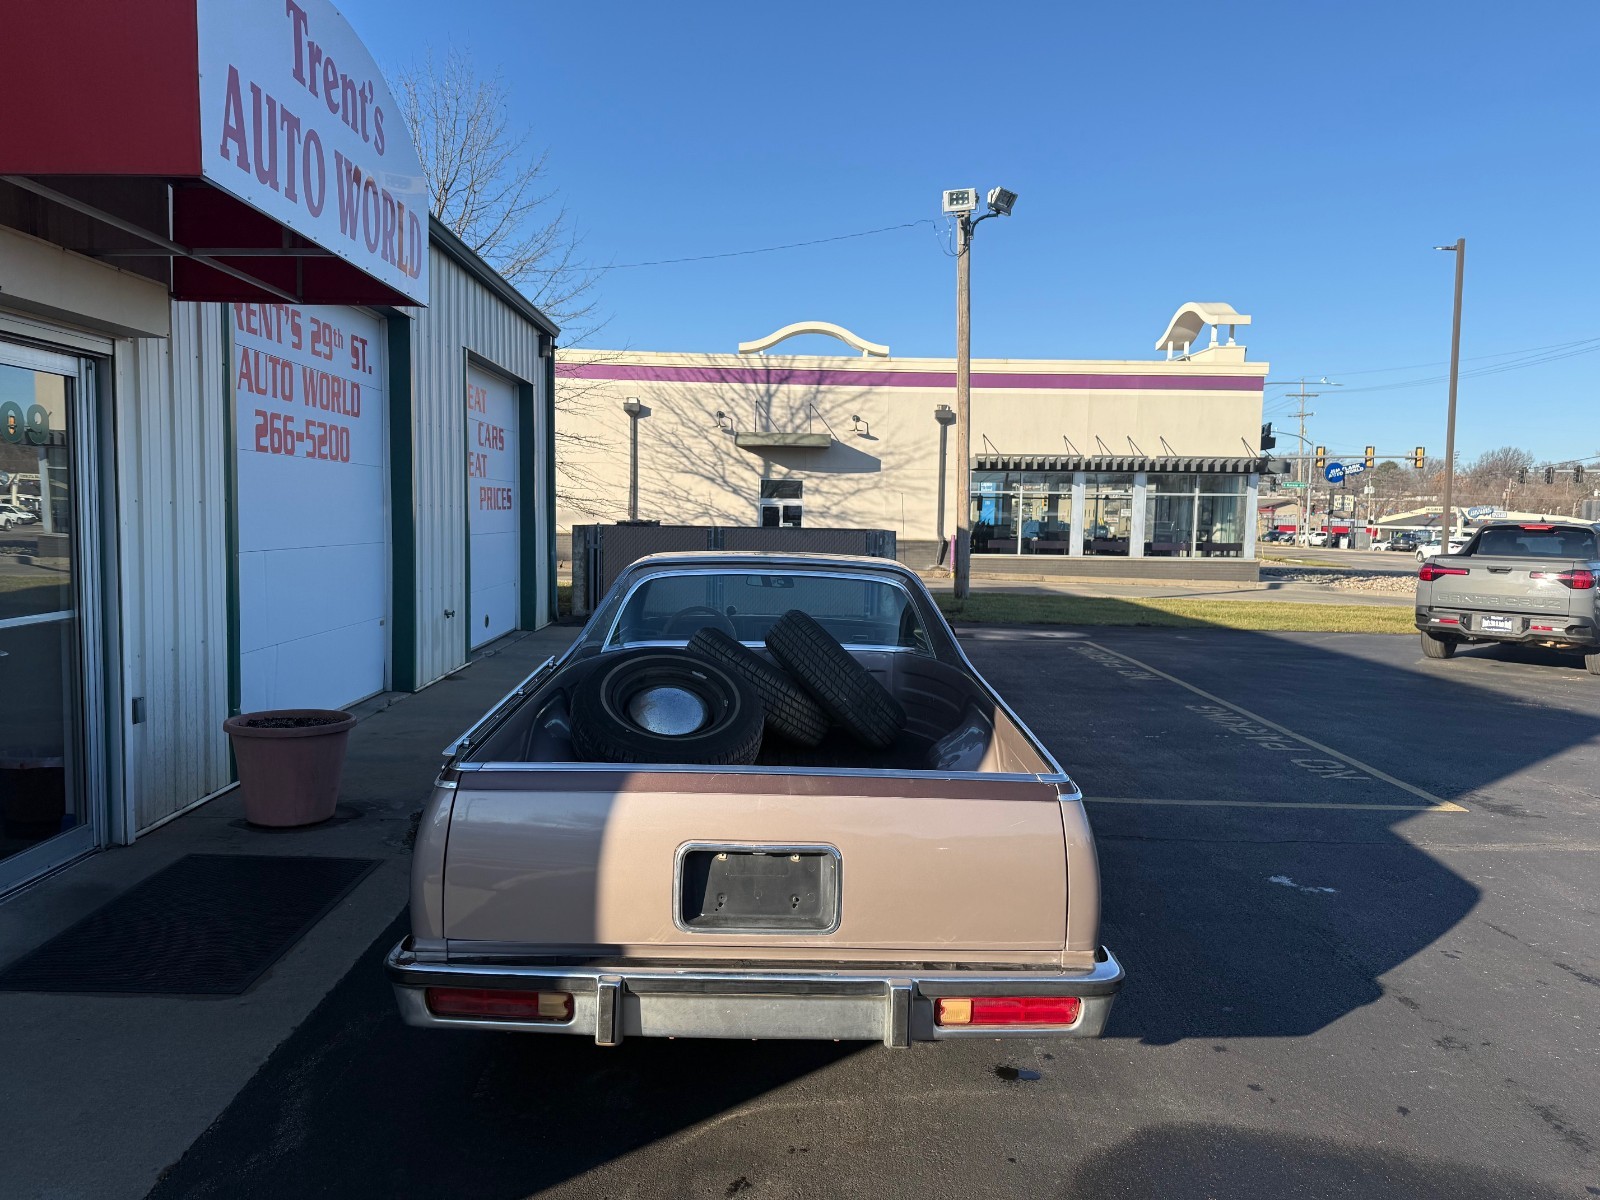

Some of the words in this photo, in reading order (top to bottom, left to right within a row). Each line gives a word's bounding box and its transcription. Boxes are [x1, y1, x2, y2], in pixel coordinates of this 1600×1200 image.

[286, 0, 385, 156] Trent's
[219, 63, 326, 218] AUTO
[334, 149, 422, 281] WORLD
[310, 316, 344, 361] 29th
[350, 333, 373, 375] ST.
[237, 347, 294, 403] AUTO
[302, 366, 361, 418] WORLD
[0, 400, 49, 444] 09
[254, 408, 350, 463] 266-5200
[477, 421, 504, 452] CARS
[479, 486, 512, 511] PRICES
